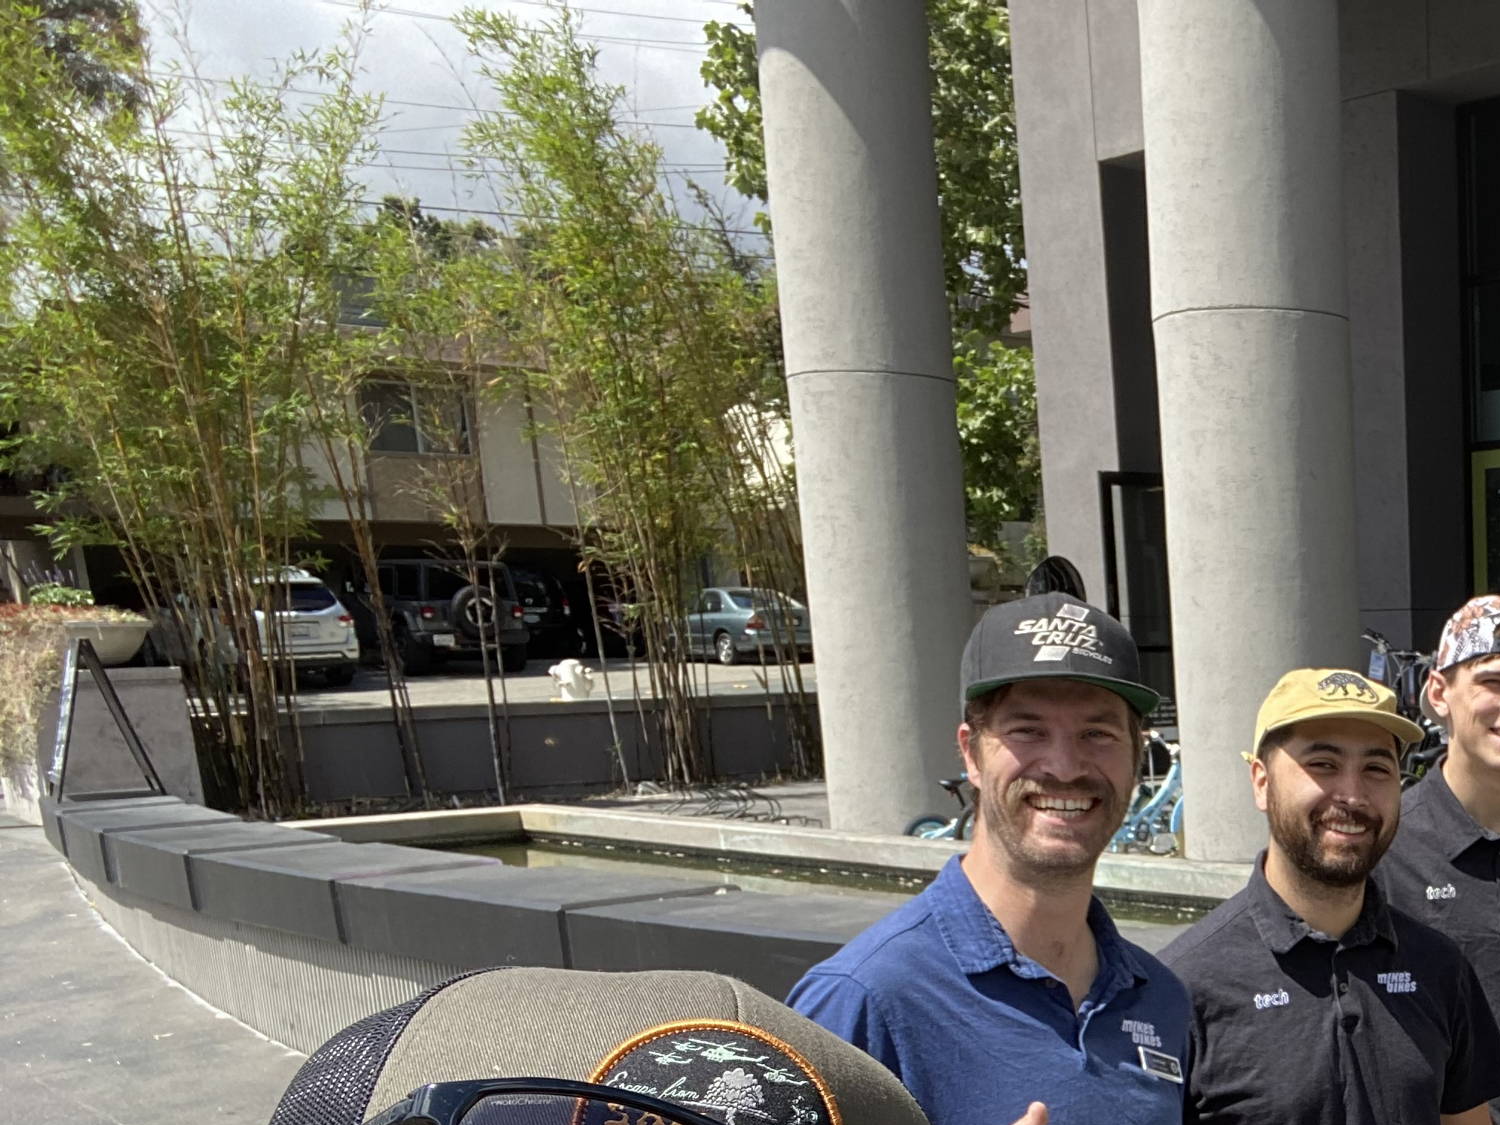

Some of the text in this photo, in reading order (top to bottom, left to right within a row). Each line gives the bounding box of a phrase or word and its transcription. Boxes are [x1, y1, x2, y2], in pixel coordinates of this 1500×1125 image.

[1013, 618, 1097, 639] SANTA
[1031, 631, 1100, 651] CRUZ
[1425, 883, 1457, 901] tech
[1253, 988, 1290, 1010] tech
